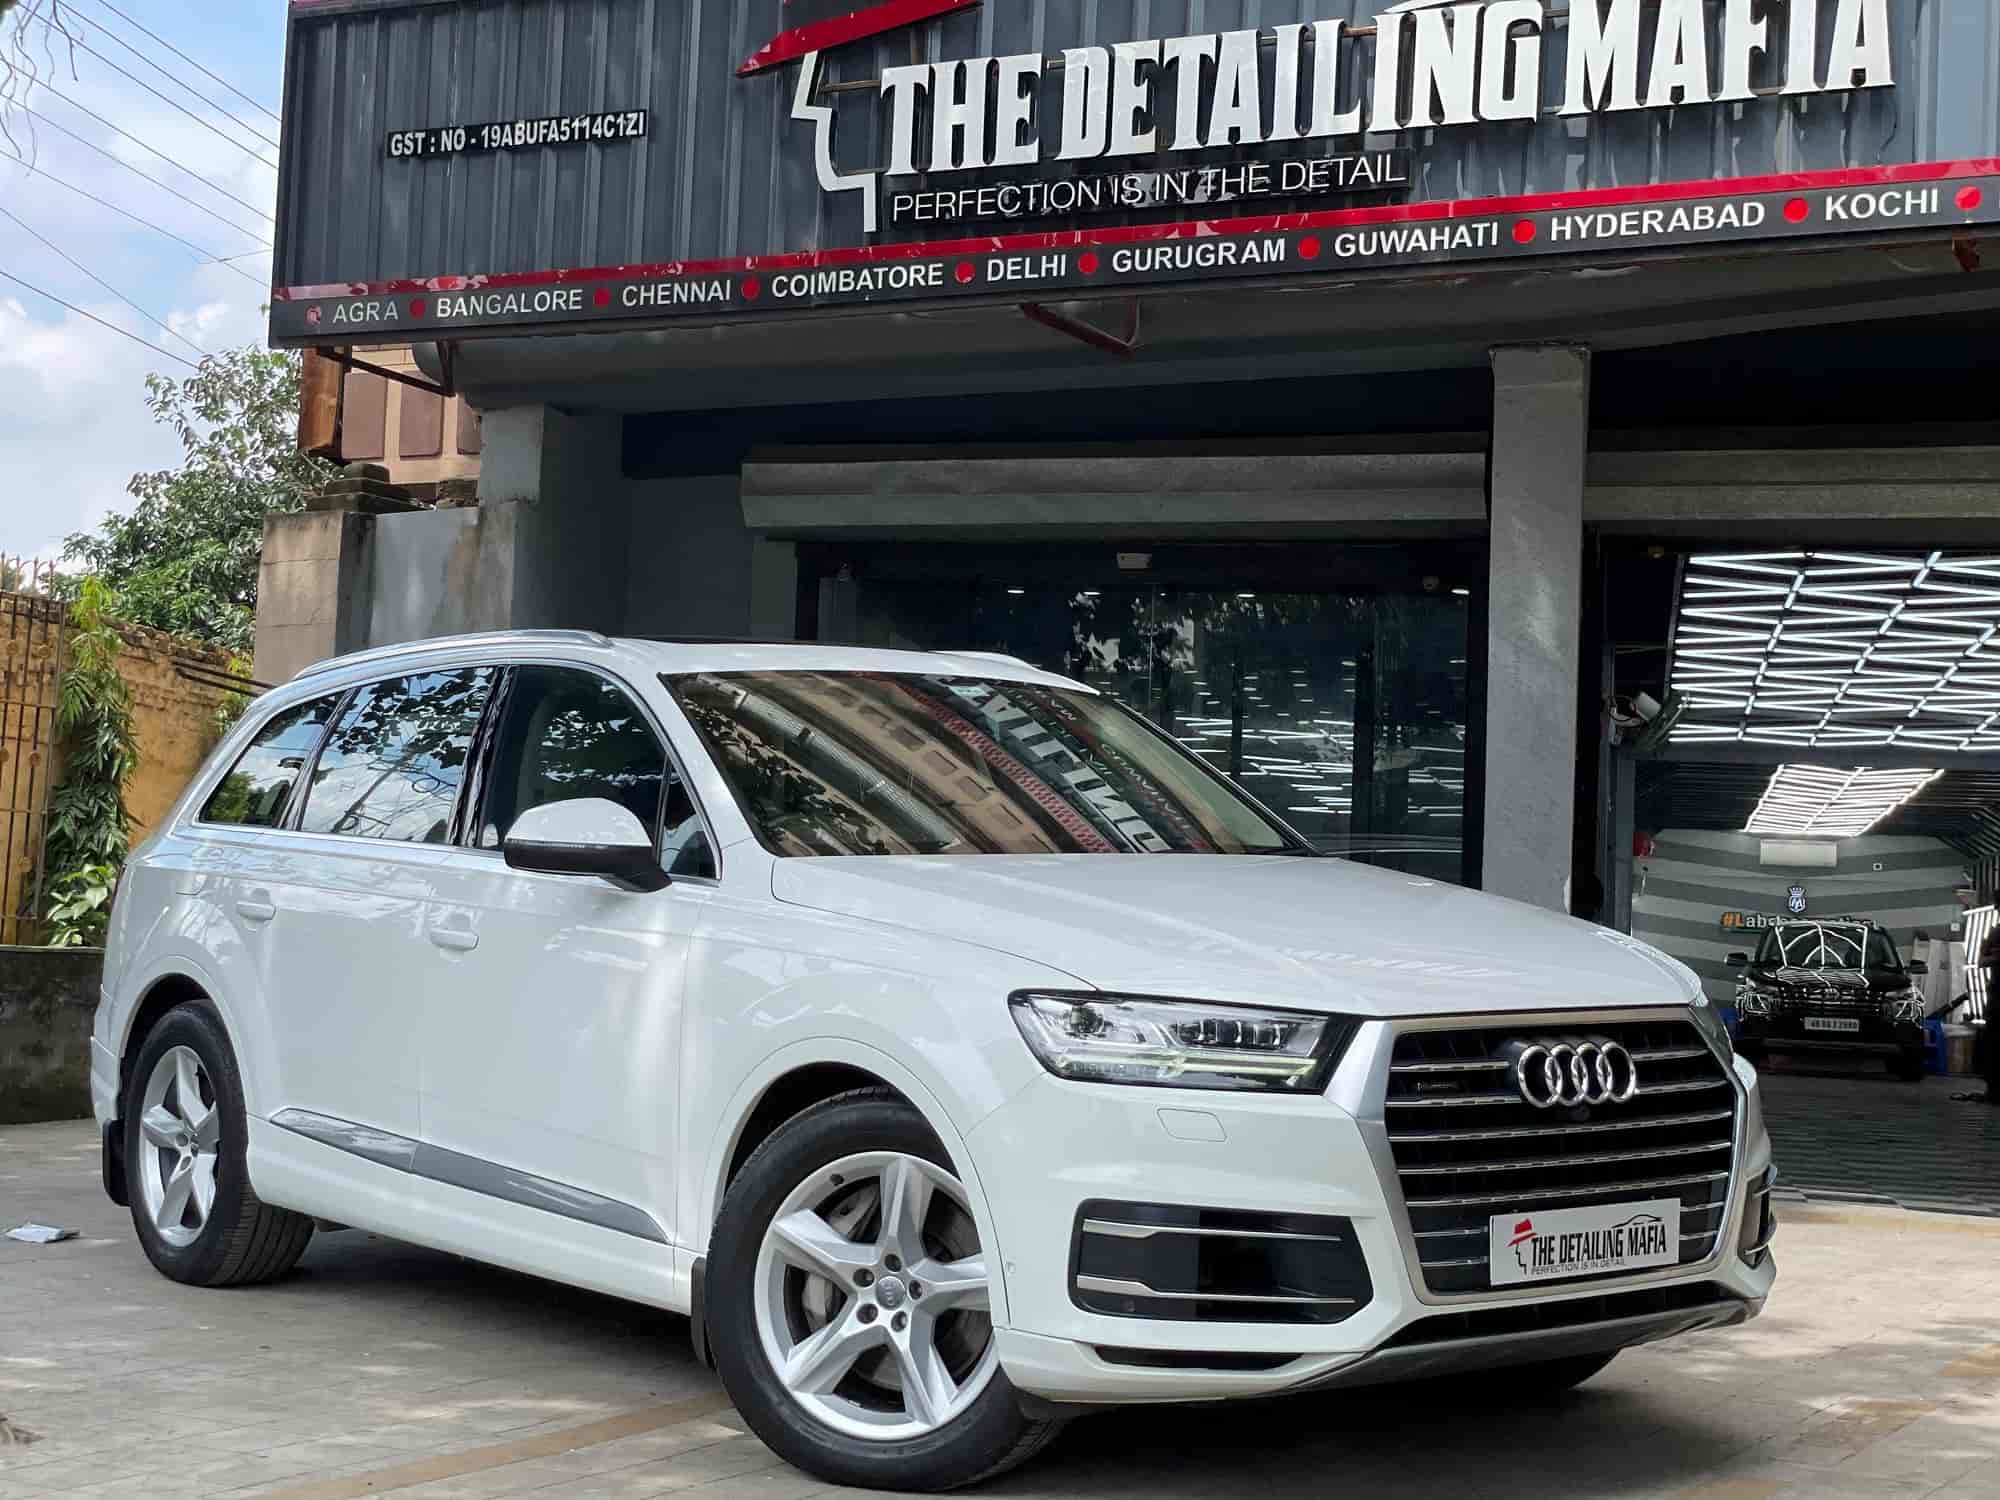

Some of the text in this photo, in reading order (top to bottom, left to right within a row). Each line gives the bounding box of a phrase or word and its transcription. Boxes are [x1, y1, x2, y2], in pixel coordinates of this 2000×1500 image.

[881, 0, 1896, 175] THE DETAILING MAFIA
[391, 131, 426, 156] GST
[441, 128, 466, 152] NO
[893, 153, 1406, 222] PERFECTION IS IN THE DETAIL
[332, 188, 1938, 324] AGRA BANGALORE CHENNAI COIMBATORE DELHI GURUGRAM GUWAHATI HYDERABAD KOCHI
[1531, 1223, 1667, 1266] THE DETAILING MAFIA
[1531, 1262, 1579, 1276] PERFECTION
